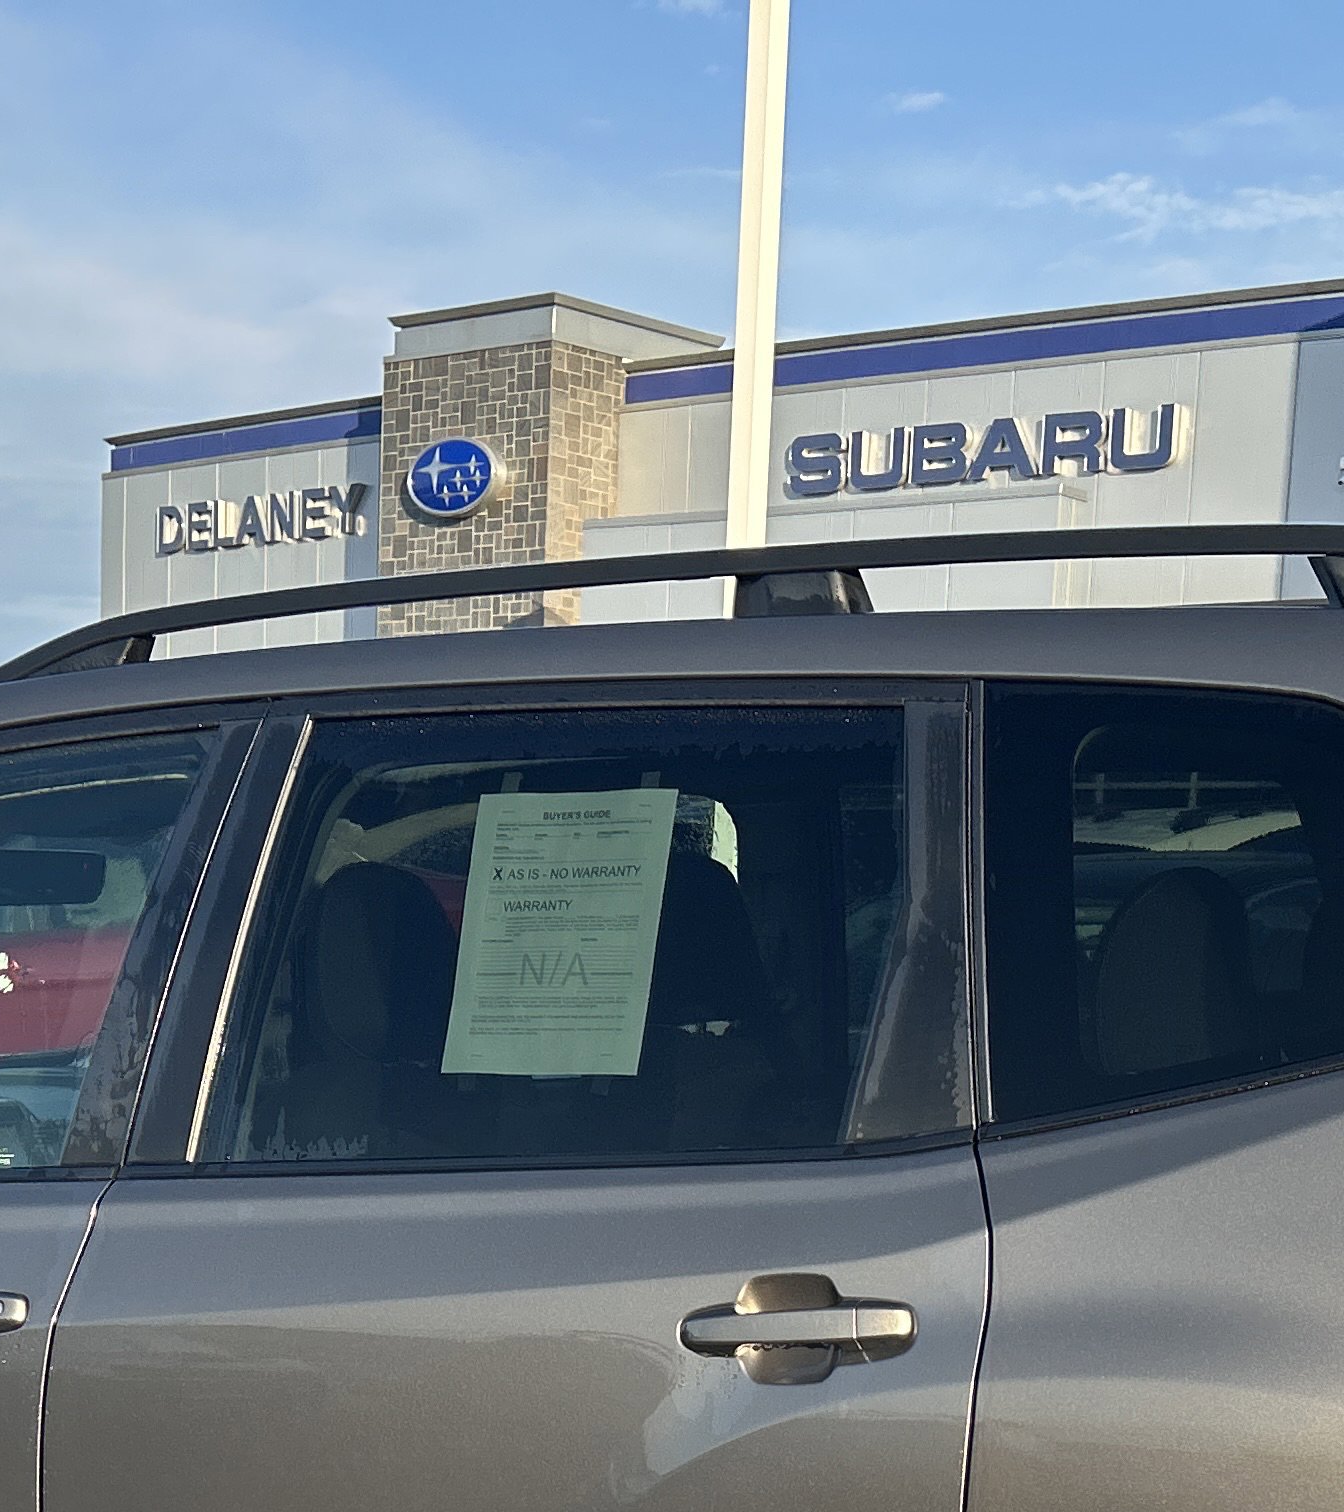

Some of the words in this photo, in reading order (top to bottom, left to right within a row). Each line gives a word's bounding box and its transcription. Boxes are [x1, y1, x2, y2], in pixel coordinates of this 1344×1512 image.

[787, 402, 1179, 497] SUBARU
[156, 483, 367, 555] DELANEY
[542, 810, 581, 821] BUYER'S
[583, 809, 612, 819] GUIDE
[507, 868, 525, 881] AS
[527, 868, 540, 880] IS
[550, 867, 569, 880] NO
[572, 864, 642, 879] WARRANTY
[503, 900, 573, 912] WARRANTY
[519, 950, 589, 986] N/A
